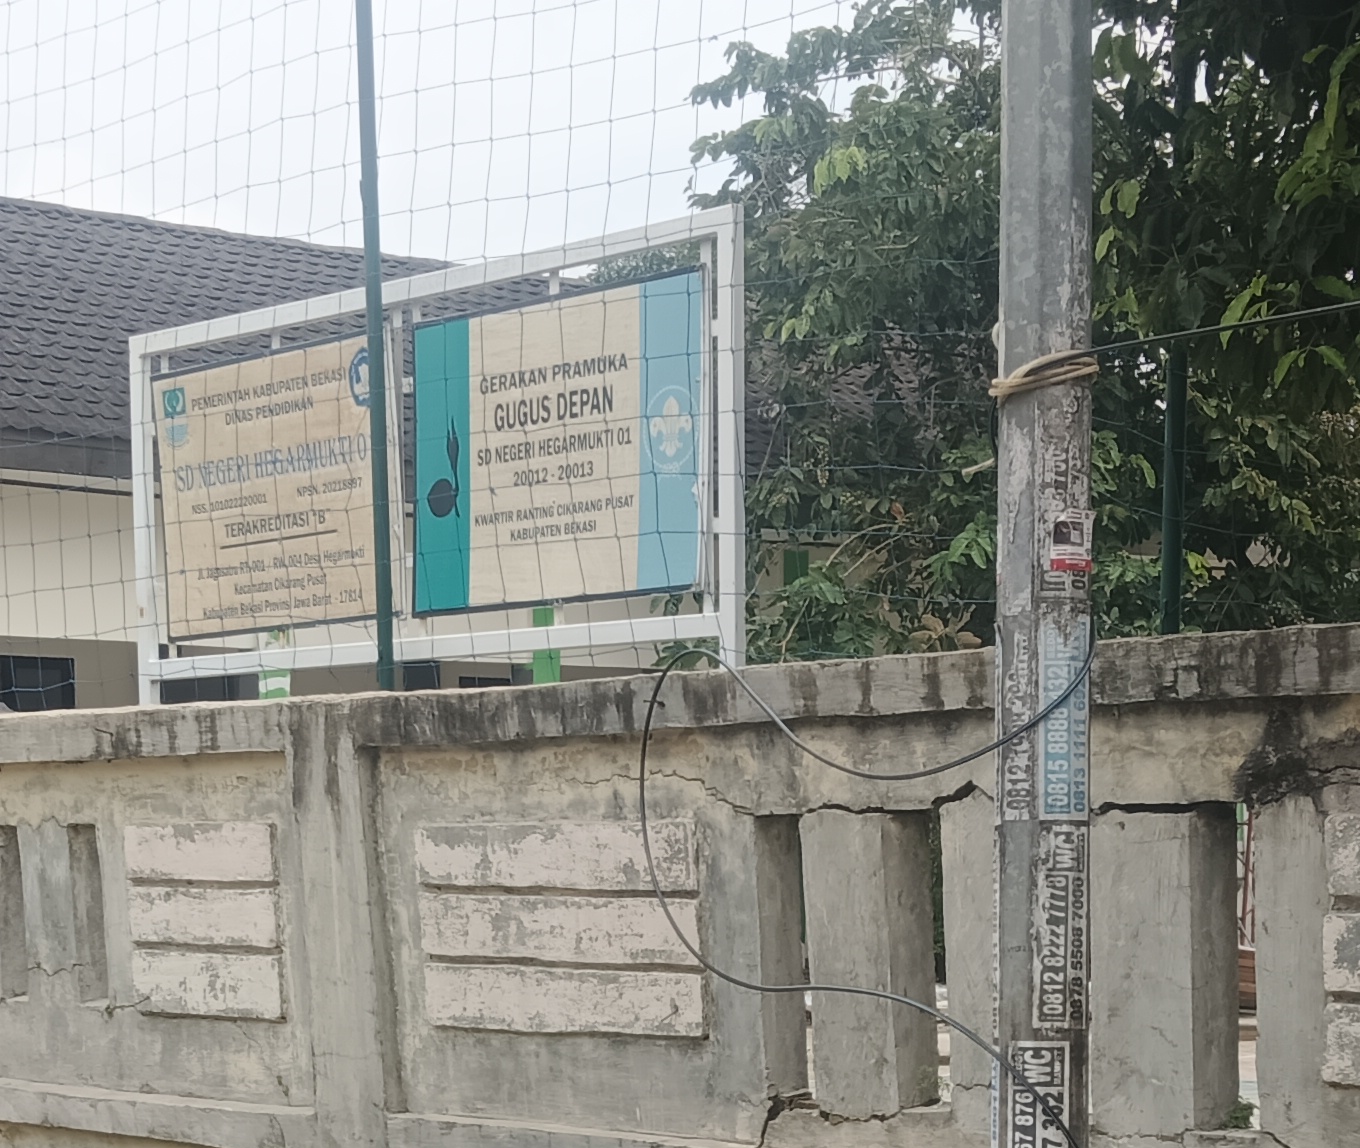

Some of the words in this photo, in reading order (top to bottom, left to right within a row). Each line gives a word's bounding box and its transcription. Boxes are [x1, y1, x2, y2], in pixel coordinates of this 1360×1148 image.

[191, 388, 251, 411] PEMERINTAH
[253, 376, 309, 399] KABUPATEN
[311, 366, 346, 387] BEKASI
[480, 368, 548, 395] GERAKAN
[552, 353, 628, 381] PRAMUKA
[225, 407, 253, 425] DINAS
[256, 396, 314, 420] PENDIDIKAN
[494, 395, 551, 432] GUGUS
[557, 384, 614, 421] DEPAN
[176, 464, 194, 493] SD
[198, 454, 251, 489] NEGERI
[254, 435, 353, 479] HEGARMUKTI
[477, 449, 491, 466] SD
[495, 441, 535, 464] NEGERI
[539, 428, 614, 457] HEGARMUKTI
[617, 426, 632, 445] 01
[513, 468, 548, 487] 20012
[558, 461, 594, 481] 20013
[224, 514, 309, 538] TERAKREDITASI
[474, 510, 514, 527] KWARTIR
[516, 505, 554, 522] RANTING
[556, 499, 602, 517] CIKARANG
[605, 494, 634, 509] PUSAT
[510, 523, 562, 542] KABUPATEN
[564, 519, 596, 534] BEKASI
[1048, 708, 1068, 753] 8888
[1074, 718, 1085, 760] 1111
[1047, 759, 1068, 806] 0815
[1074, 768, 1085, 812] 0813
[1055, 834, 1078, 869] WC
[1071, 877, 1083, 921] 7000
[1042, 924, 1065, 966] 8222
[1071, 926, 1083, 971] 5508
[1043, 972, 1064, 1014] 0812
[1024, 1050, 1051, 1084] WC
[1015, 1092, 1034, 1126] 876
